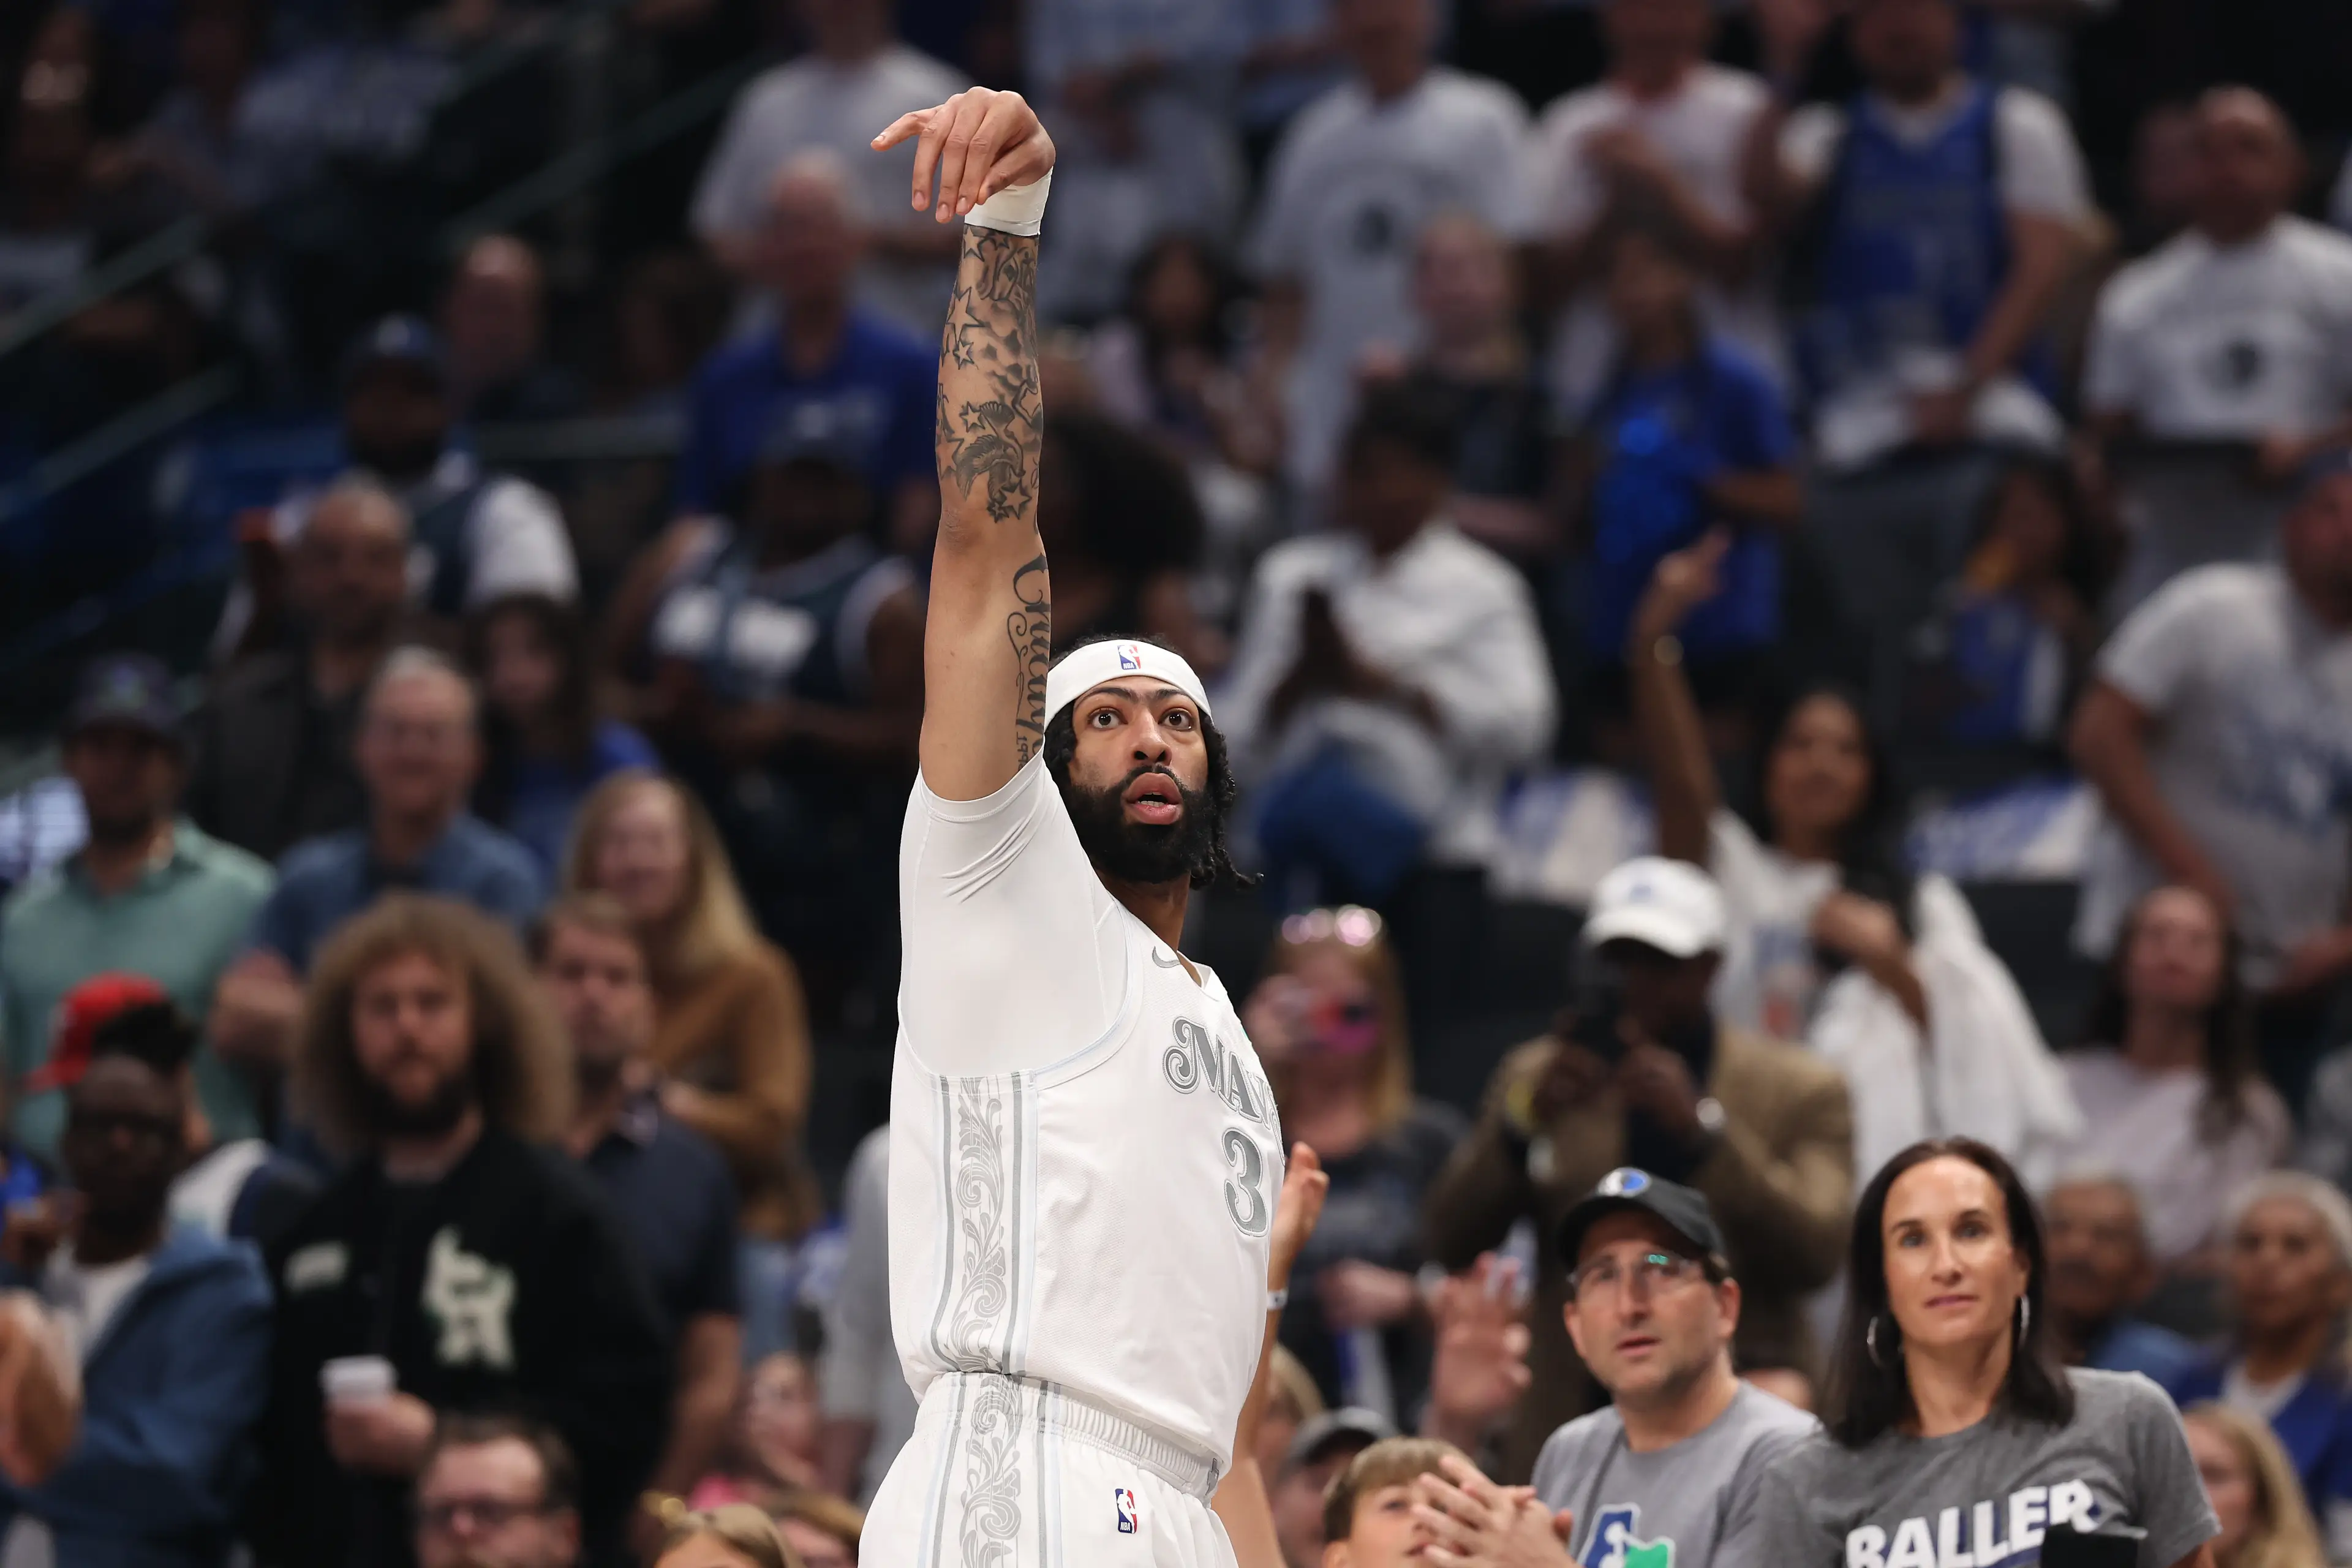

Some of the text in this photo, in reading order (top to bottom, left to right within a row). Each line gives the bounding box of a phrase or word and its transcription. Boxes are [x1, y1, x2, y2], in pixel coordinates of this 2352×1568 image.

[1222, 1128, 1268, 1237] 3
[1120, 1521, 1131, 1531] NBA
[1845, 1478, 2100, 1567] BALLER
